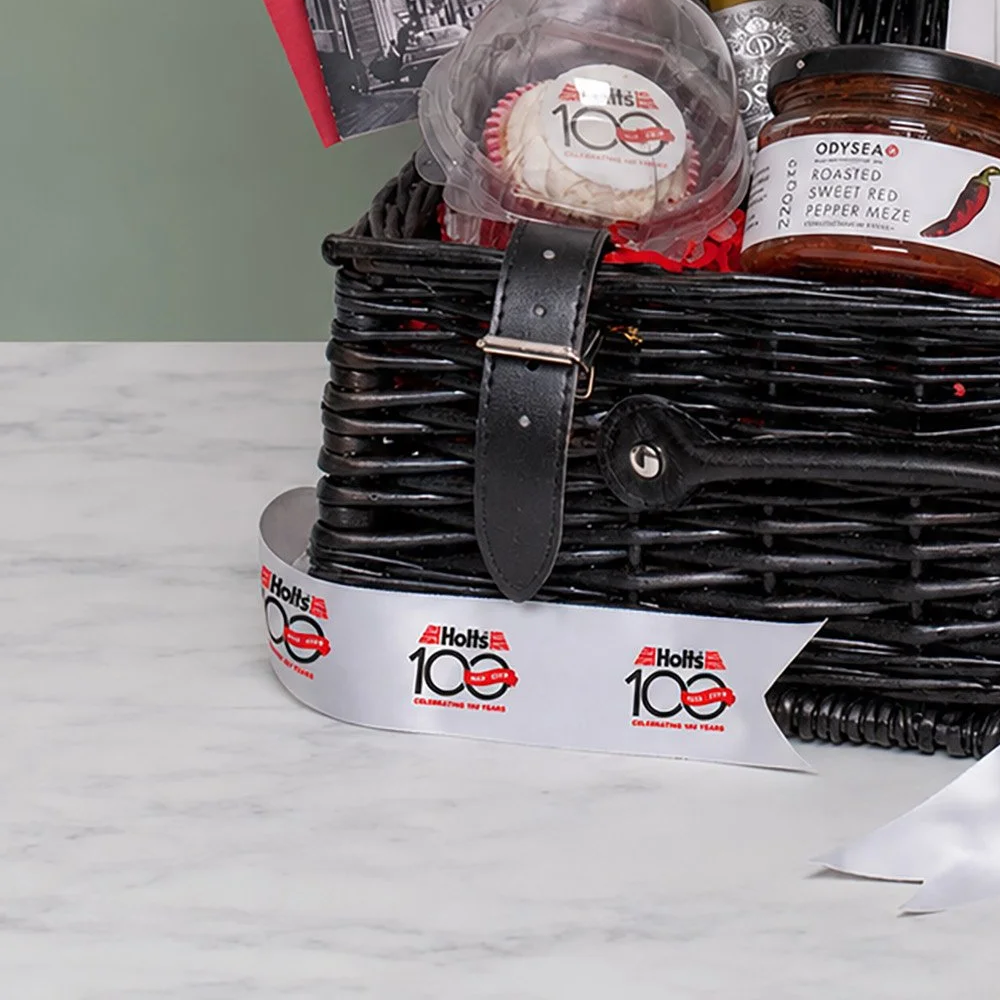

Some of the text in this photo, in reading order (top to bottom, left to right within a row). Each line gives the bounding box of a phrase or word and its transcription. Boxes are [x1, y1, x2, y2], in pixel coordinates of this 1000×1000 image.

[552, 103, 676, 156] 100
[815, 141, 884, 157] ODYSEA
[811, 167, 882, 182] ROASTED
[808, 185, 898, 202] SWEET RED
[805, 203, 911, 223] PEPPER MEZE
[408, 646, 511, 701] 100
[624, 668, 727, 721] 100
